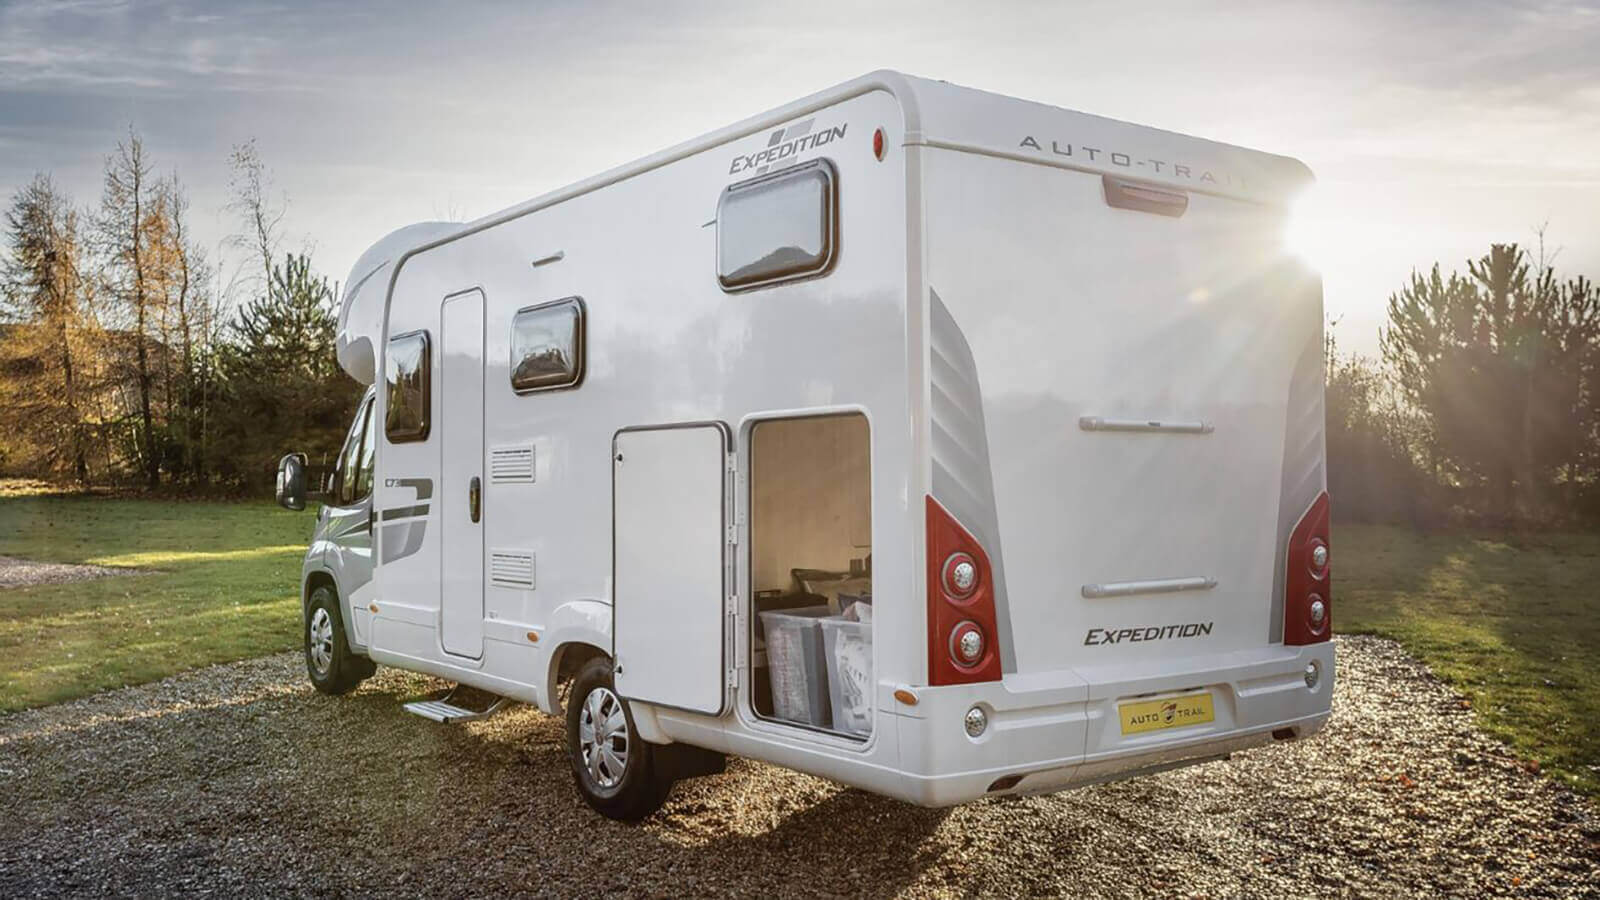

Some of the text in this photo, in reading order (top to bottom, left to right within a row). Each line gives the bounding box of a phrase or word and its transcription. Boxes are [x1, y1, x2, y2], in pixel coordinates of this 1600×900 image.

[729, 123, 848, 175] EXPEDITION
[1084, 622, 1213, 646] EXPEDITION
[1130, 707, 1206, 726] AUTO TRAIL
